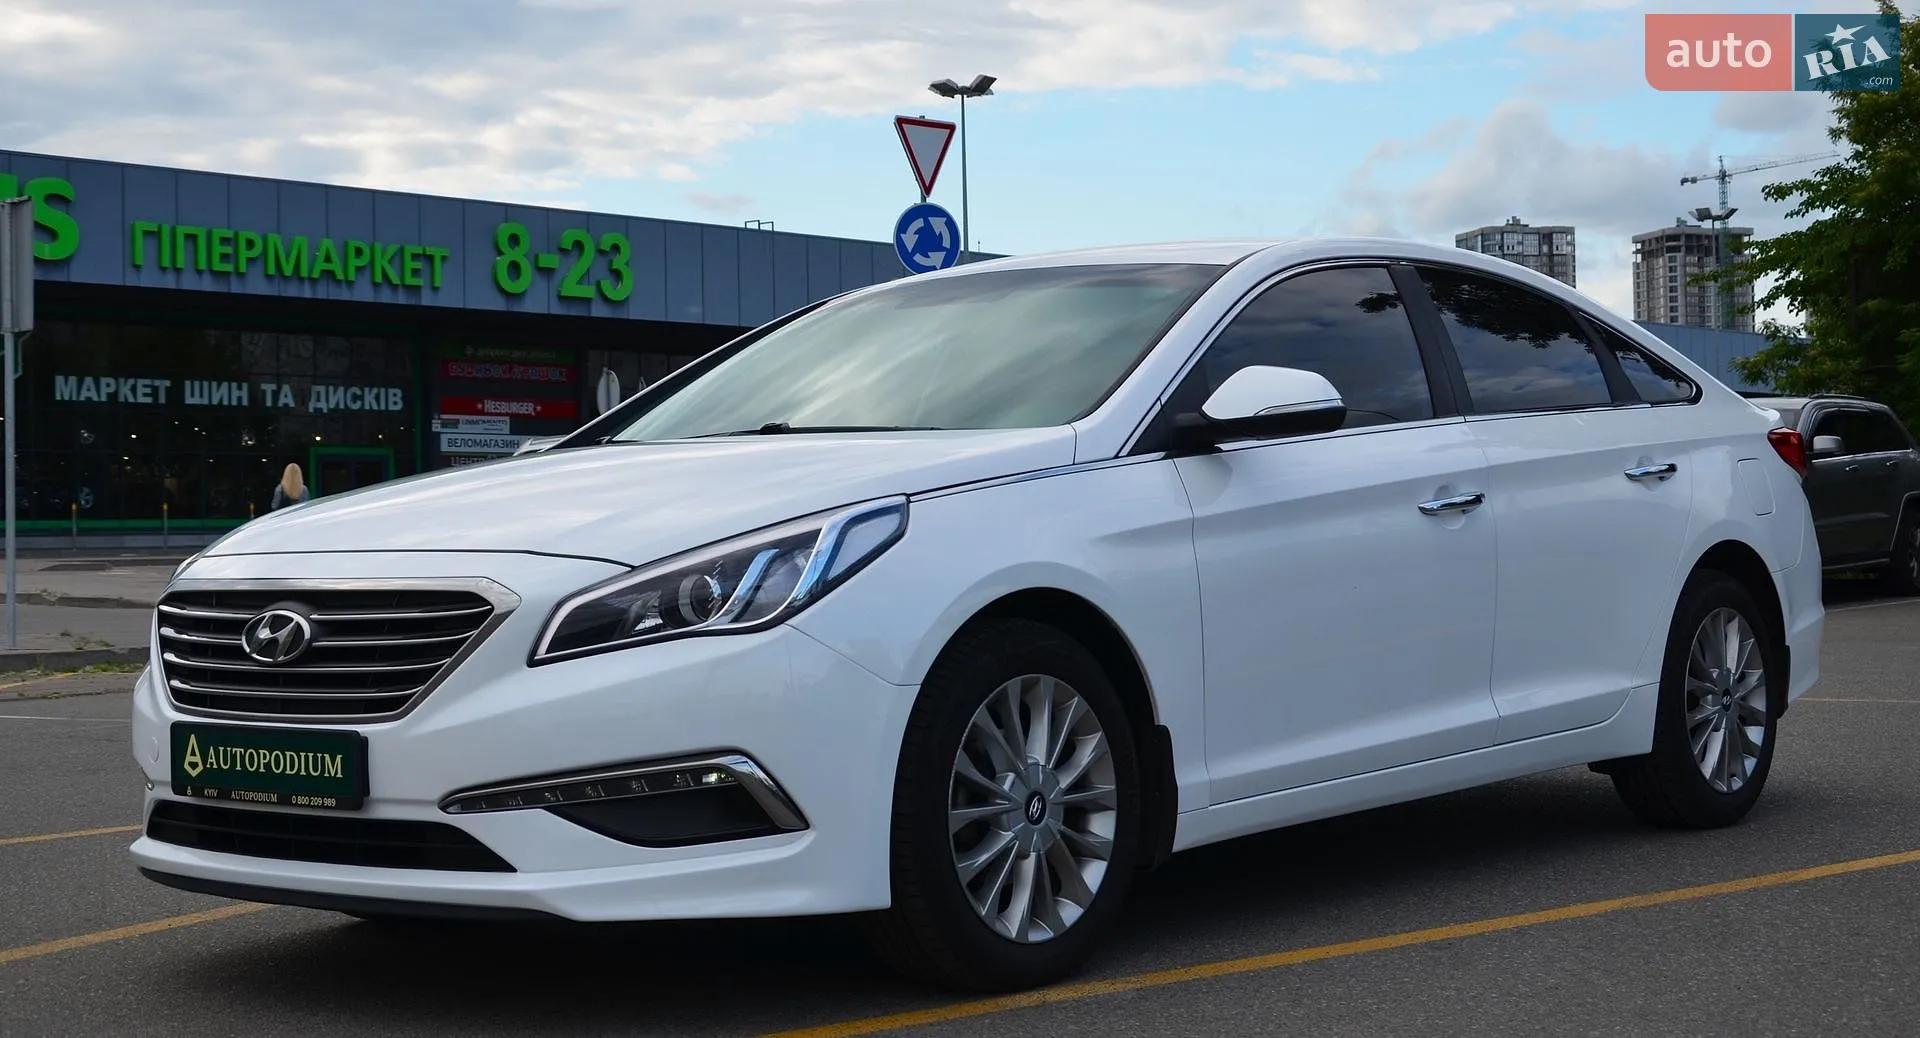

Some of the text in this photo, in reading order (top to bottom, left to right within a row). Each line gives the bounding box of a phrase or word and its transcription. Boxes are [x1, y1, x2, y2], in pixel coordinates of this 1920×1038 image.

[131, 220, 635, 302] ГІПЕРМАРКЕТ 8-23
[54, 375, 404, 413] МАРКЕТ ШИН ТА ДИСКІВ
[484, 399, 536, 416] HESBURGER
[447, 438, 520, 449] ВЕЛОМАГАЗИН
[206, 745, 344, 778] AUTOPODIUM
[204, 788, 218, 798] KYIV
[230, 790, 278, 803] AUTOPODIUM
[297, 795, 310, 805] 800
[310, 796, 323, 807] 209
[323, 797, 337, 808] 989
